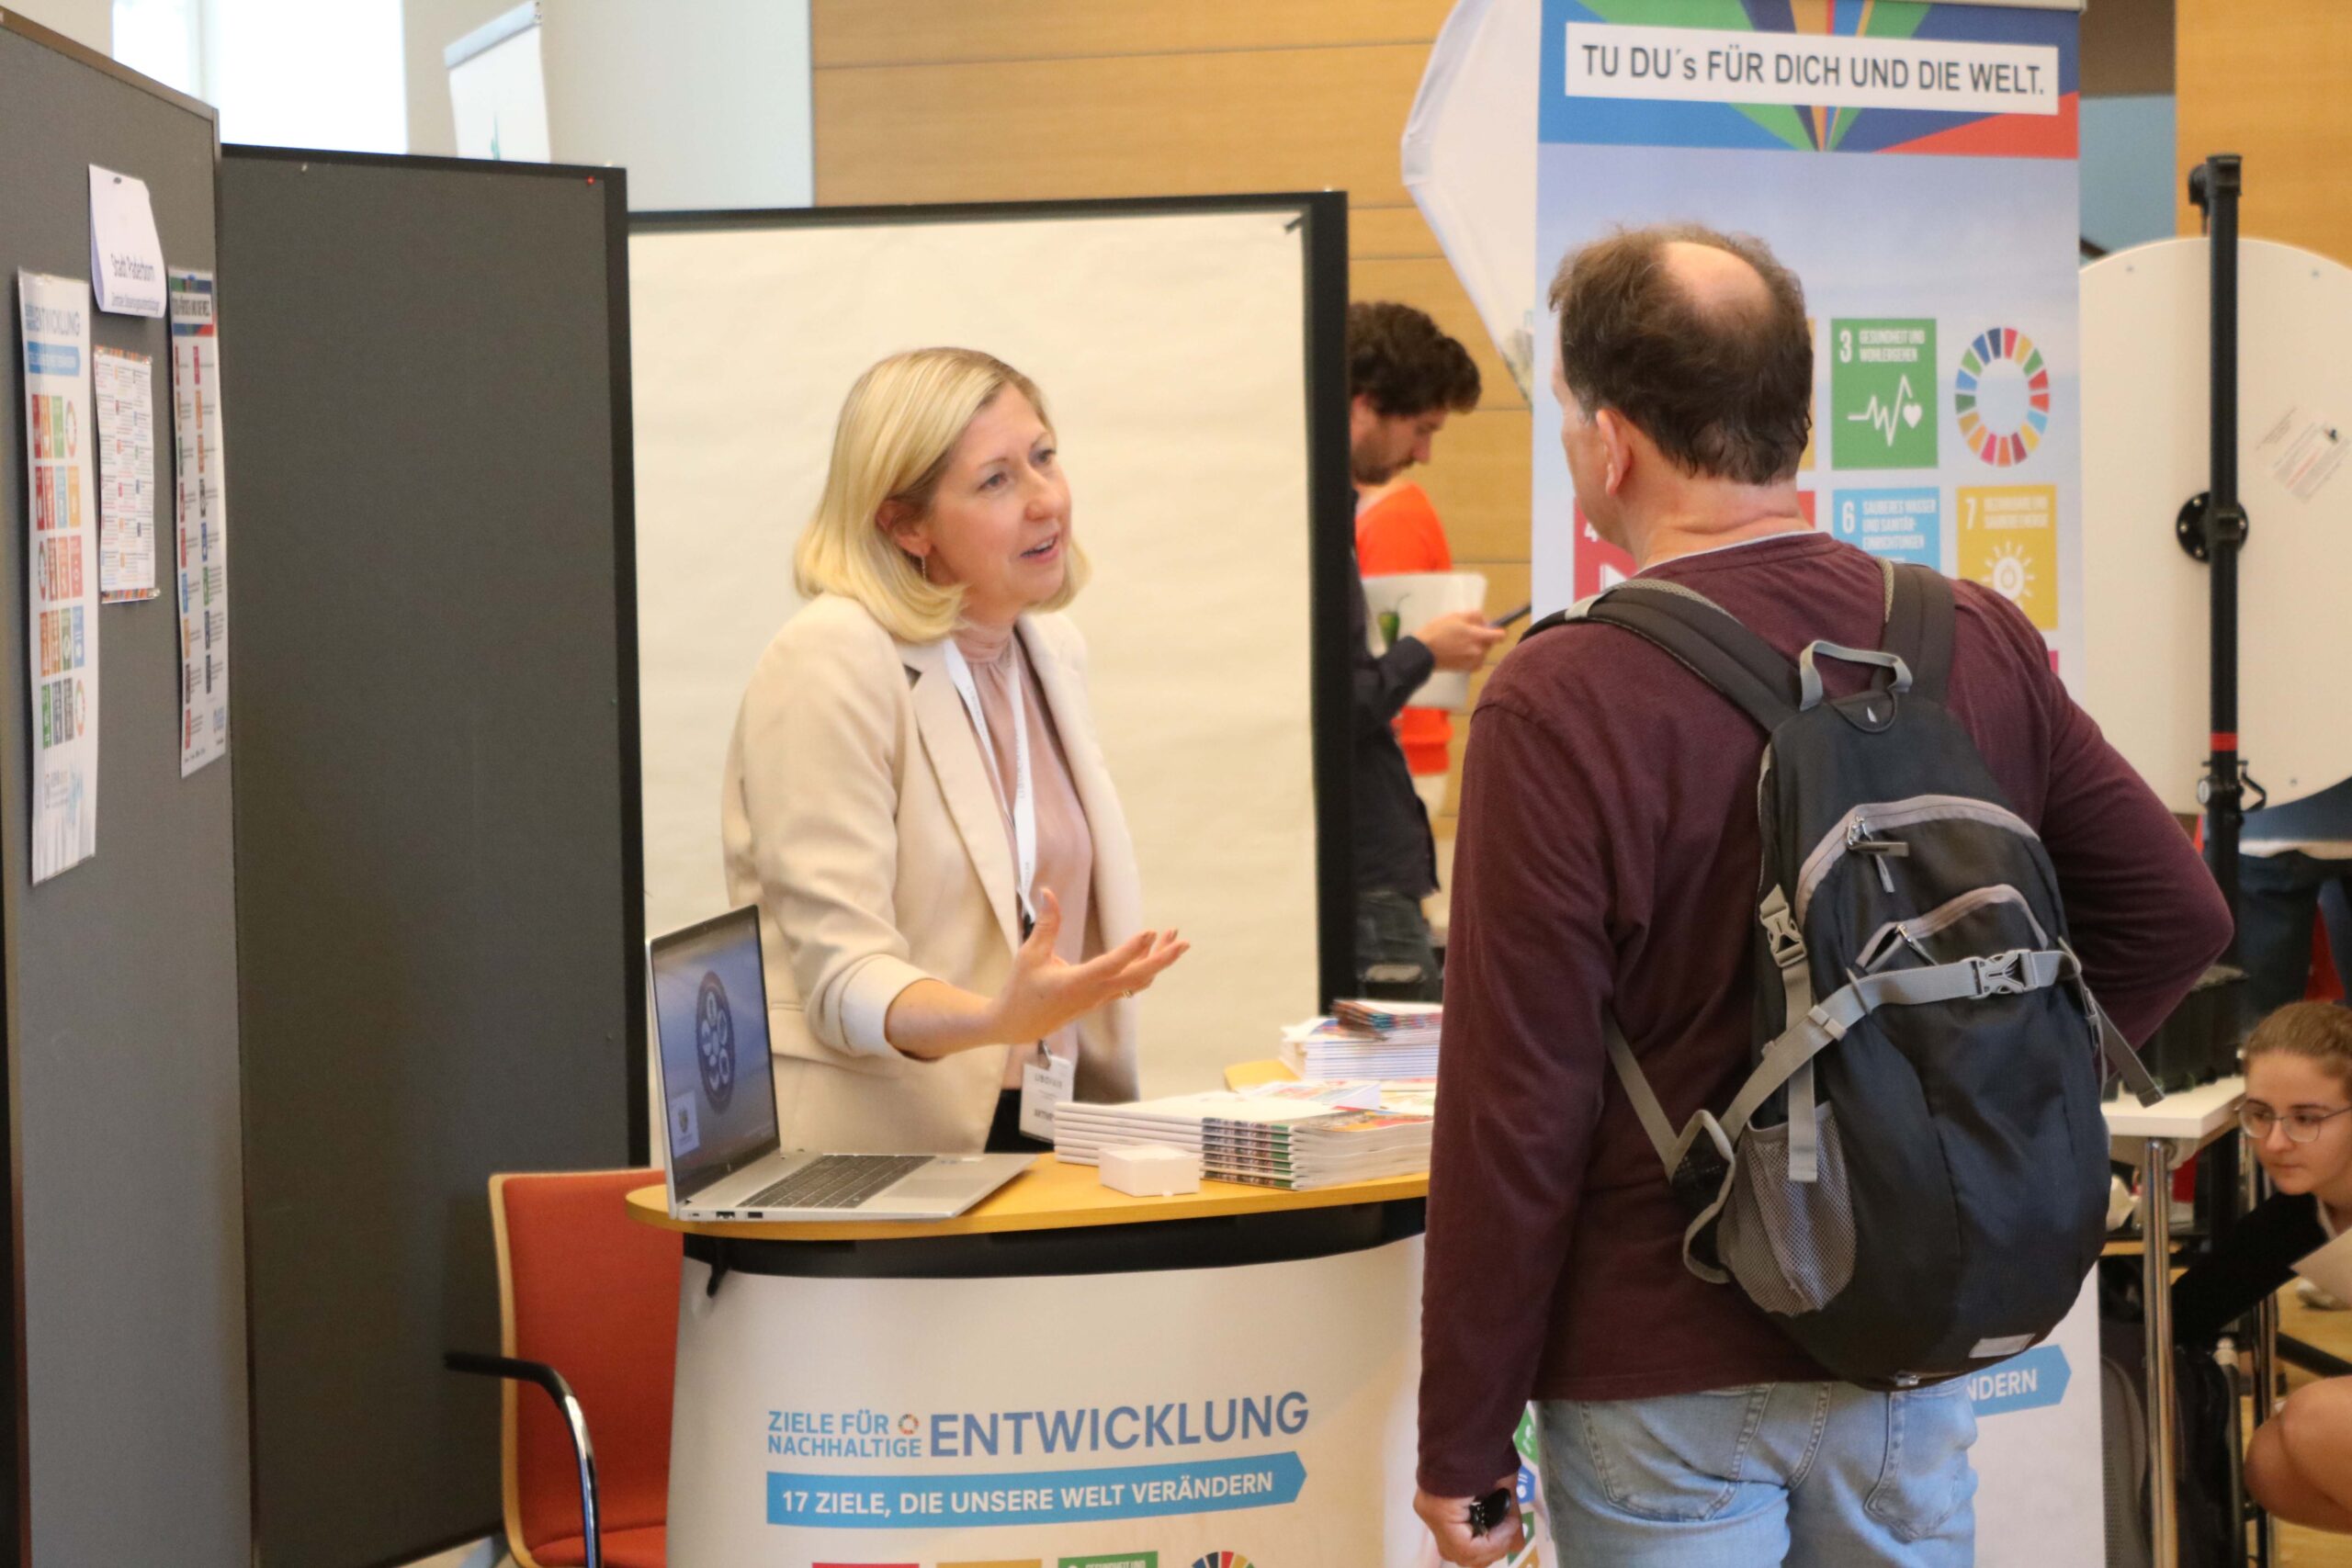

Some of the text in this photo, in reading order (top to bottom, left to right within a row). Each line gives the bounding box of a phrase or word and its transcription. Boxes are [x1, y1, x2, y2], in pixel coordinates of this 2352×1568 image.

[1581, 44, 1619, 77] TU
[1708, 43, 1764, 84] FÜR
[1775, 53, 1840, 86] DICH
[1850, 56, 1909, 89] UND
[1918, 60, 1961, 91] DIE
[1969, 62, 2044, 96] WELT.
[1839, 328, 1852, 364] 3
[1842, 500, 1855, 535] 6
[1966, 1369, 2038, 1401] NDERN
[767, 1408, 889, 1436] ZIELE FÜR
[930, 1391, 1309, 1458] ENTWICKLUNG
[767, 1436, 922, 1459] NACHHALTIGE
[782, 1471, 1273, 1519] 17 ZIELE, DIE UNSERE WELT VERÄNDERN
